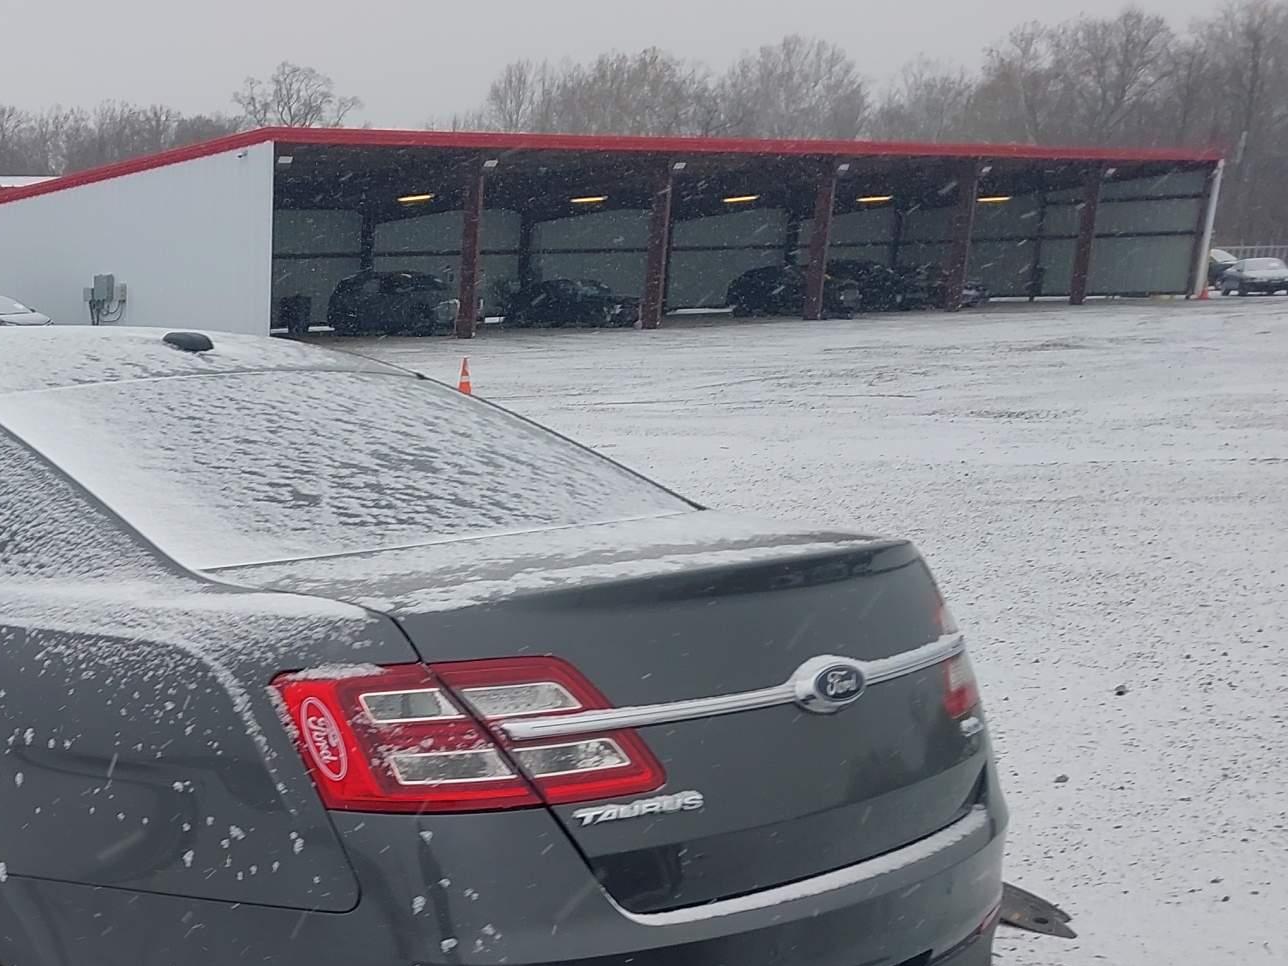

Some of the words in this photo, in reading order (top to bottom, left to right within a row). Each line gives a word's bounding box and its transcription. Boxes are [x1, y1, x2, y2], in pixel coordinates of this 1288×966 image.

[826, 670, 857, 696] Ford
[306, 715, 339, 765] Ford
[573, 790, 704, 826] TAURUS
